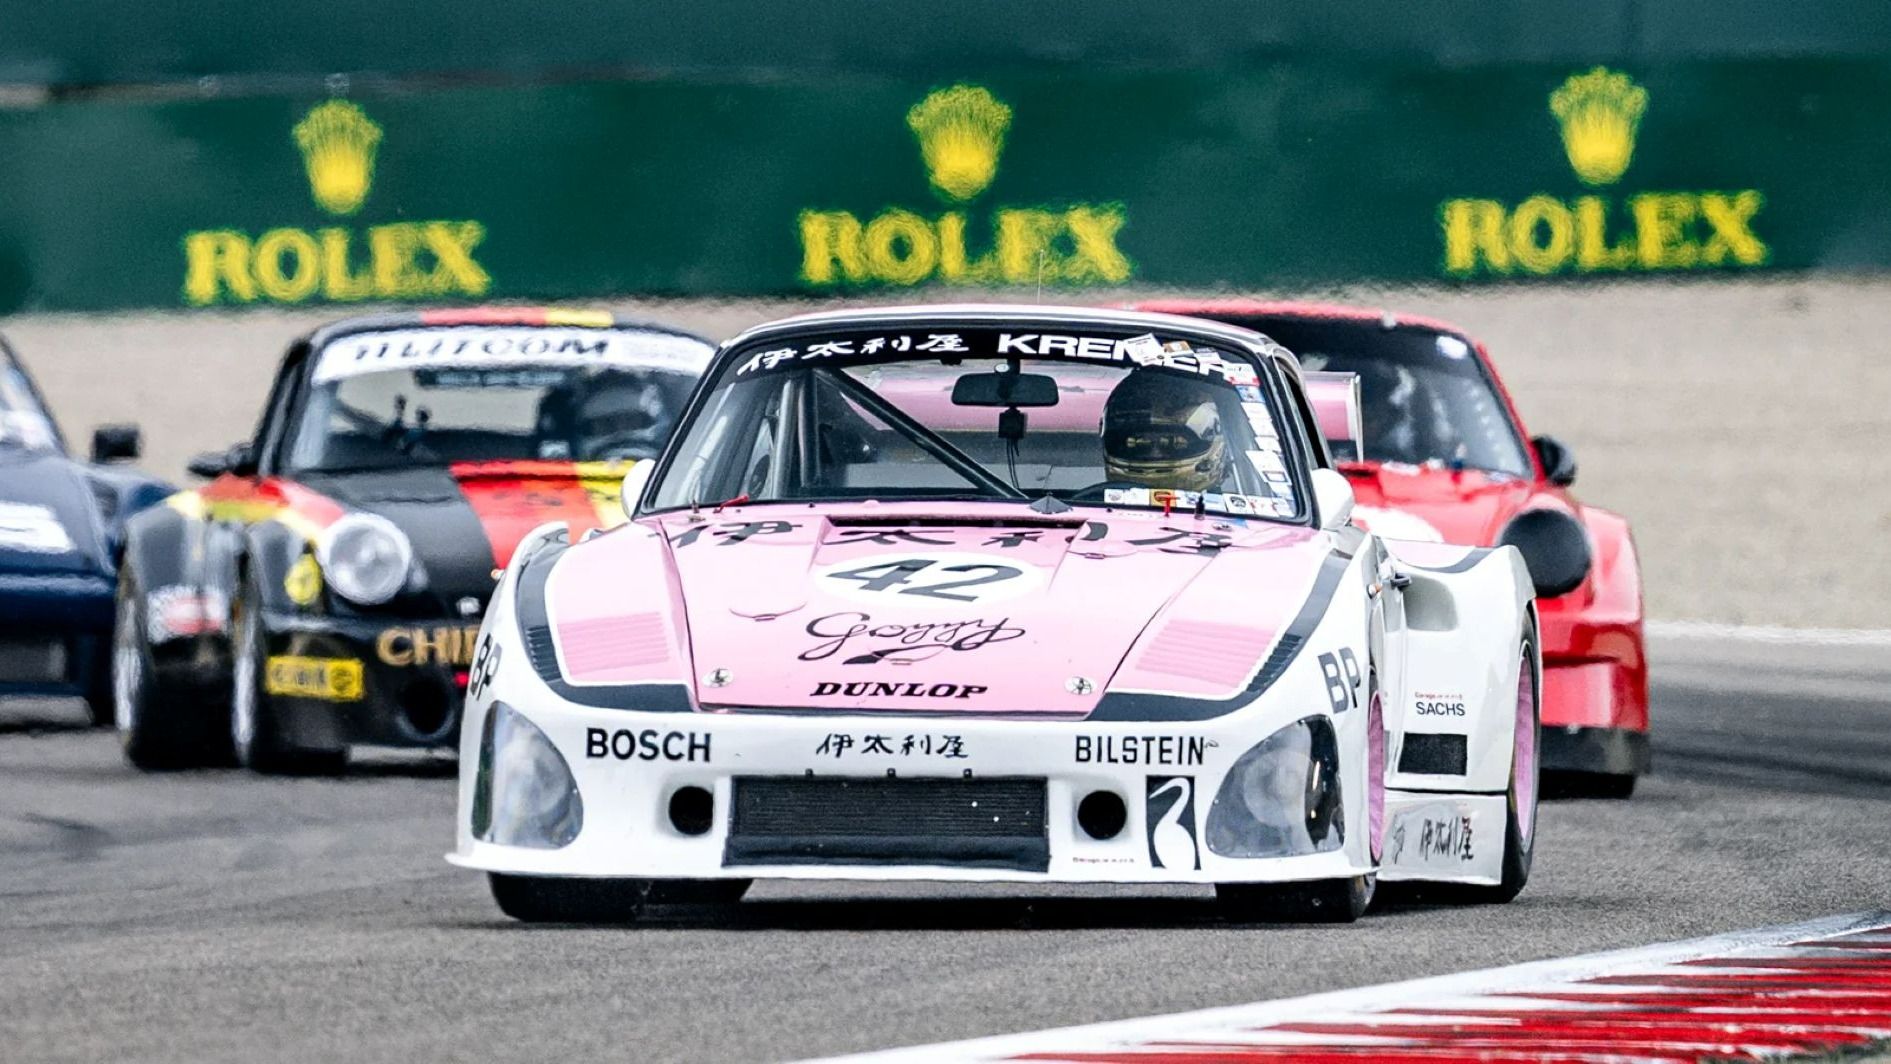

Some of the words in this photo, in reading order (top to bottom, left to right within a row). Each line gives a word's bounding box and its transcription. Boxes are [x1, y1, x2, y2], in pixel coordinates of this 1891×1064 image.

[801, 205, 1132, 284] ROLEX
[1442, 190, 1766, 273] ROLEX
[185, 221, 491, 304] ROLEX
[826, 559, 1023, 602] 42
[809, 682, 988, 699] DUNLOP
[1318, 647, 1361, 714] BP
[1416, 701, 1465, 716] SACHS
[586, 727, 711, 762] BOSCH
[1075, 735, 1204, 765] BILSTEIN
